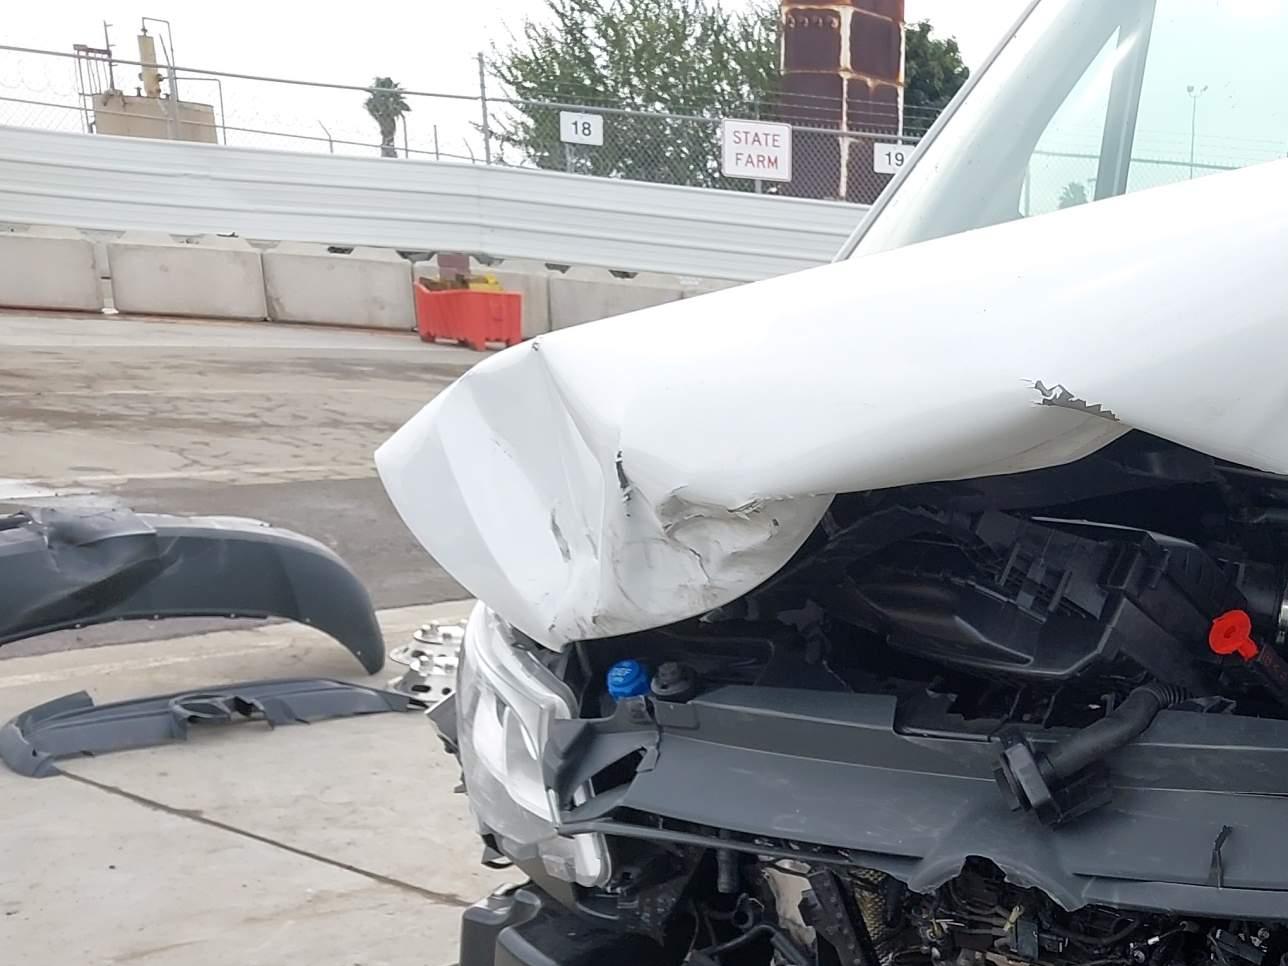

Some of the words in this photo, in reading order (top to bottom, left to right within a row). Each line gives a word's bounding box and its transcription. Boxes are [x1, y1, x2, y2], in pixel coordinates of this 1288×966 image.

[571, 120, 592, 138] 18
[732, 130, 781, 149] STATE
[735, 152, 779, 170] FARM
[884, 152, 905, 168] 19
